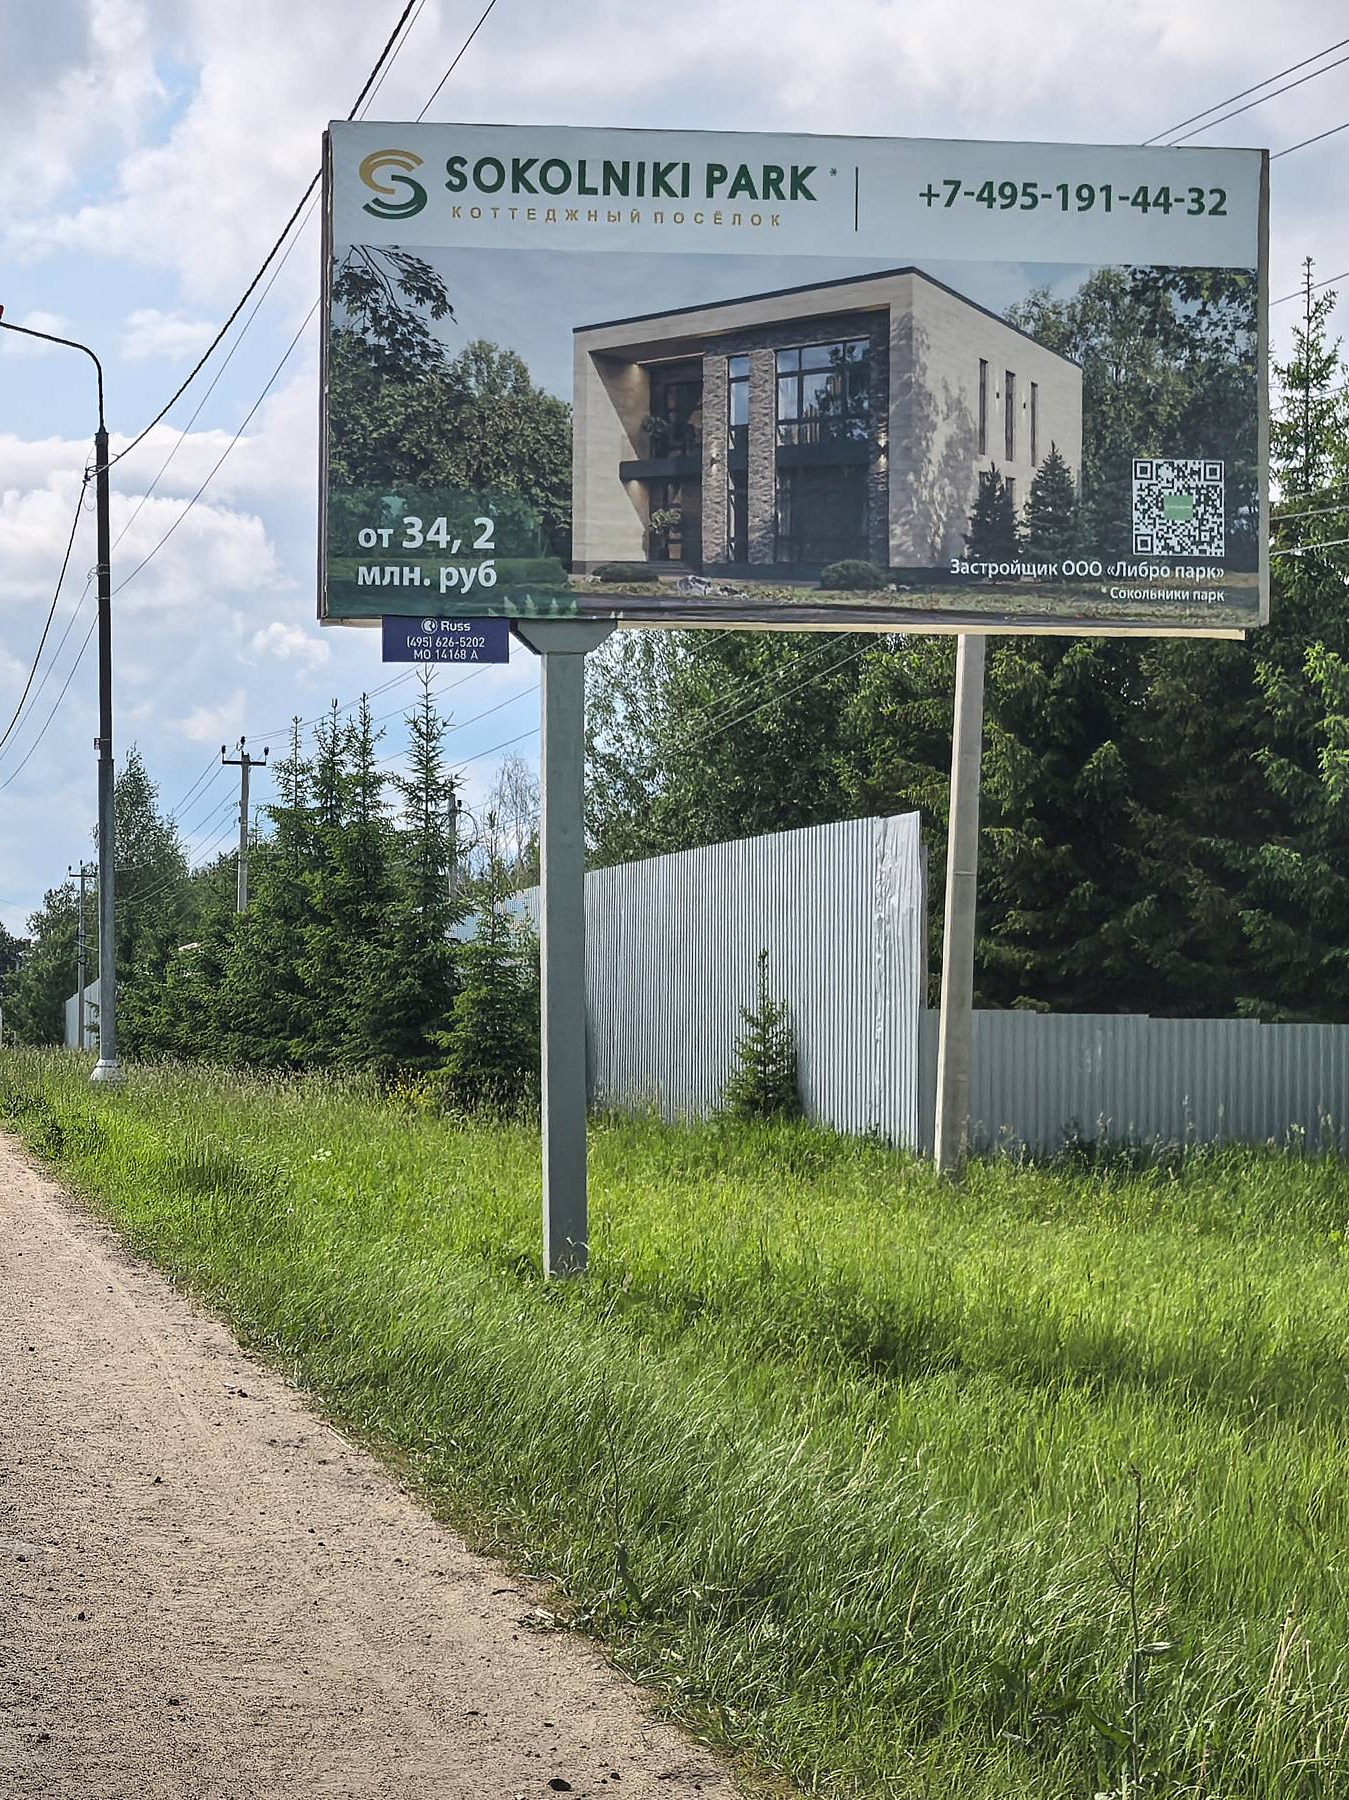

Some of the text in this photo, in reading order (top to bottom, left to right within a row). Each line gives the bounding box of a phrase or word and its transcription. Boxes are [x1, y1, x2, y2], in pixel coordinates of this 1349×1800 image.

[444, 155, 818, 201] SOKOLNIKI PARK
[919, 179, 1227, 216] +7-495-191-44-32
[452, 206, 781, 227] КОТТЕДЖНЫЙ ПОСЁЛОК
[358, 516, 495, 554] от 34, 2
[357, 560, 497, 594] млн. руб
[950, 559, 1224, 580] Застройщик ООО «Либро парк»
[1110, 587, 1225, 602] Сокольники парк
[441, 621, 471, 632] Russ
[407, 636, 485, 648] (495) 626-5202
[436, 650, 467, 660] 14168
